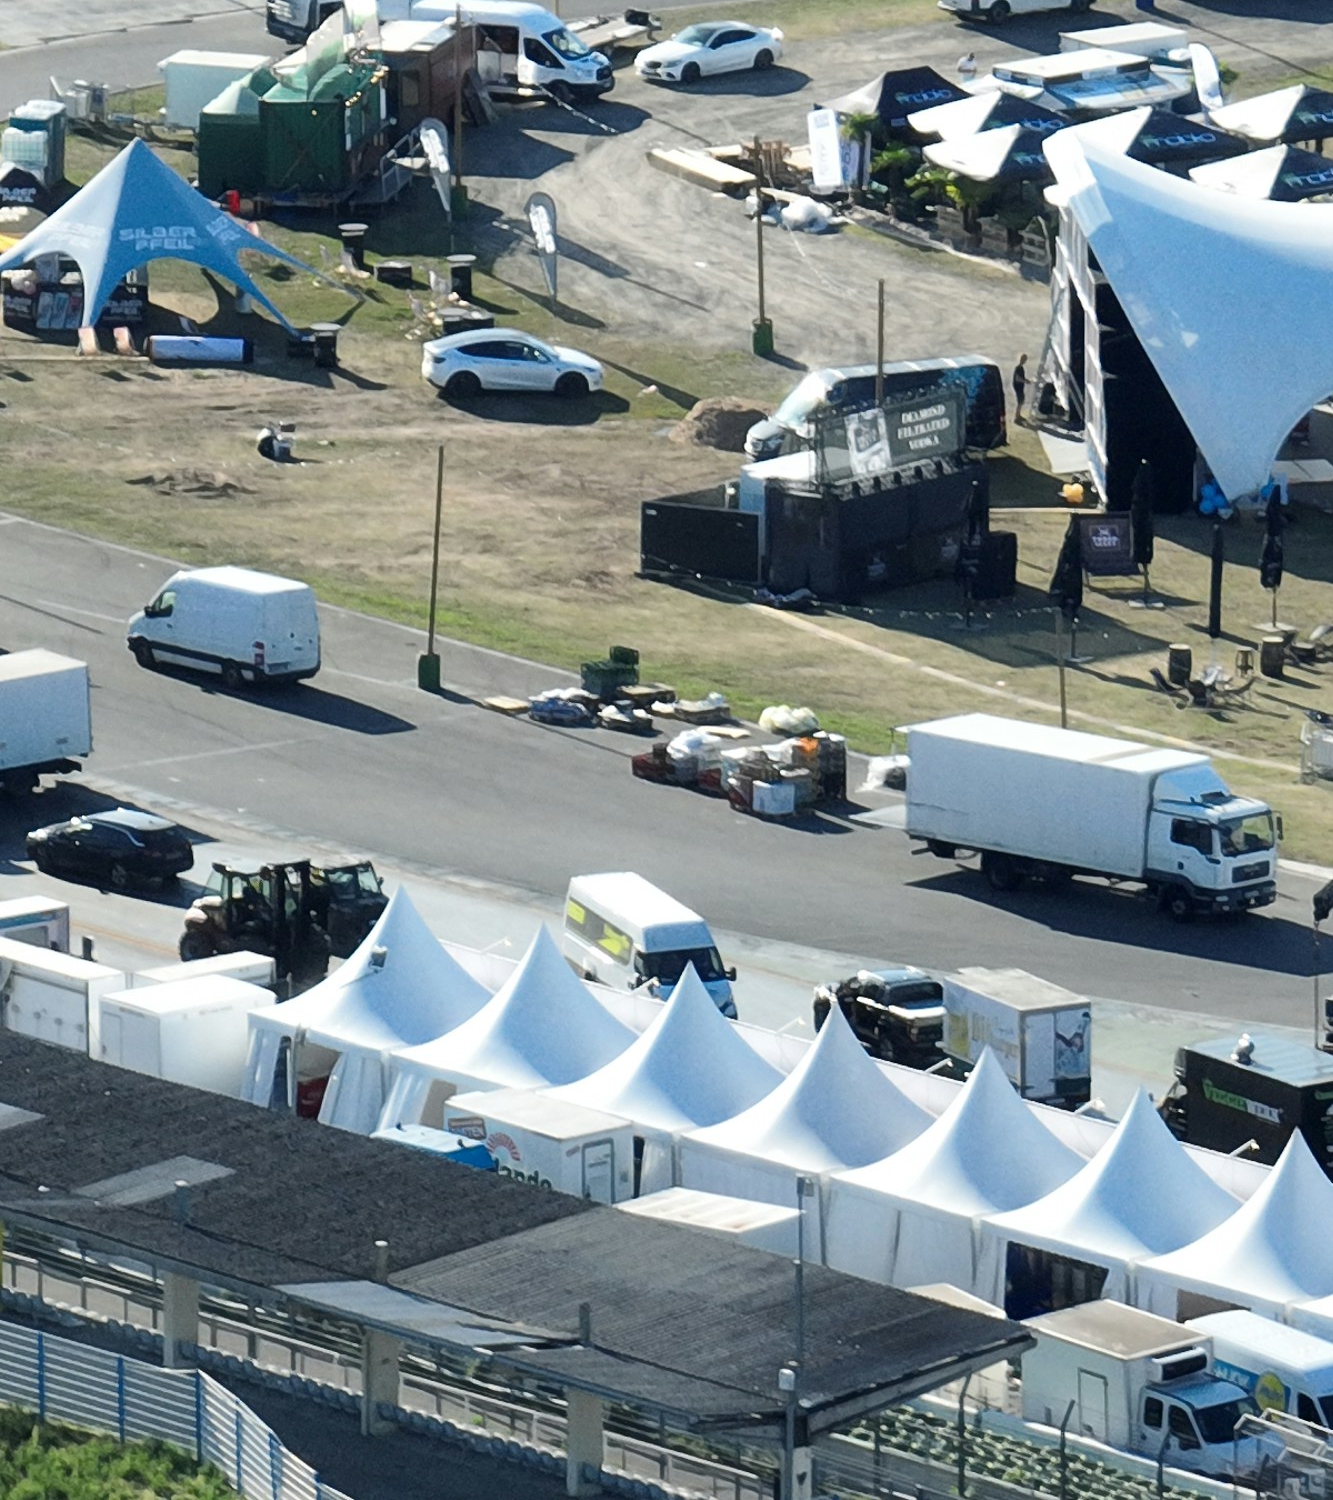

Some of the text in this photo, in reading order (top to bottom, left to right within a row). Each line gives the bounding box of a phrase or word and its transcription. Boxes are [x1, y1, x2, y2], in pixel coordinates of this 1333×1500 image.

[119, 226, 198, 242] SILBER
[135, 237, 196, 252] PFEIL
[902, 403, 946, 425] DIAMOND
